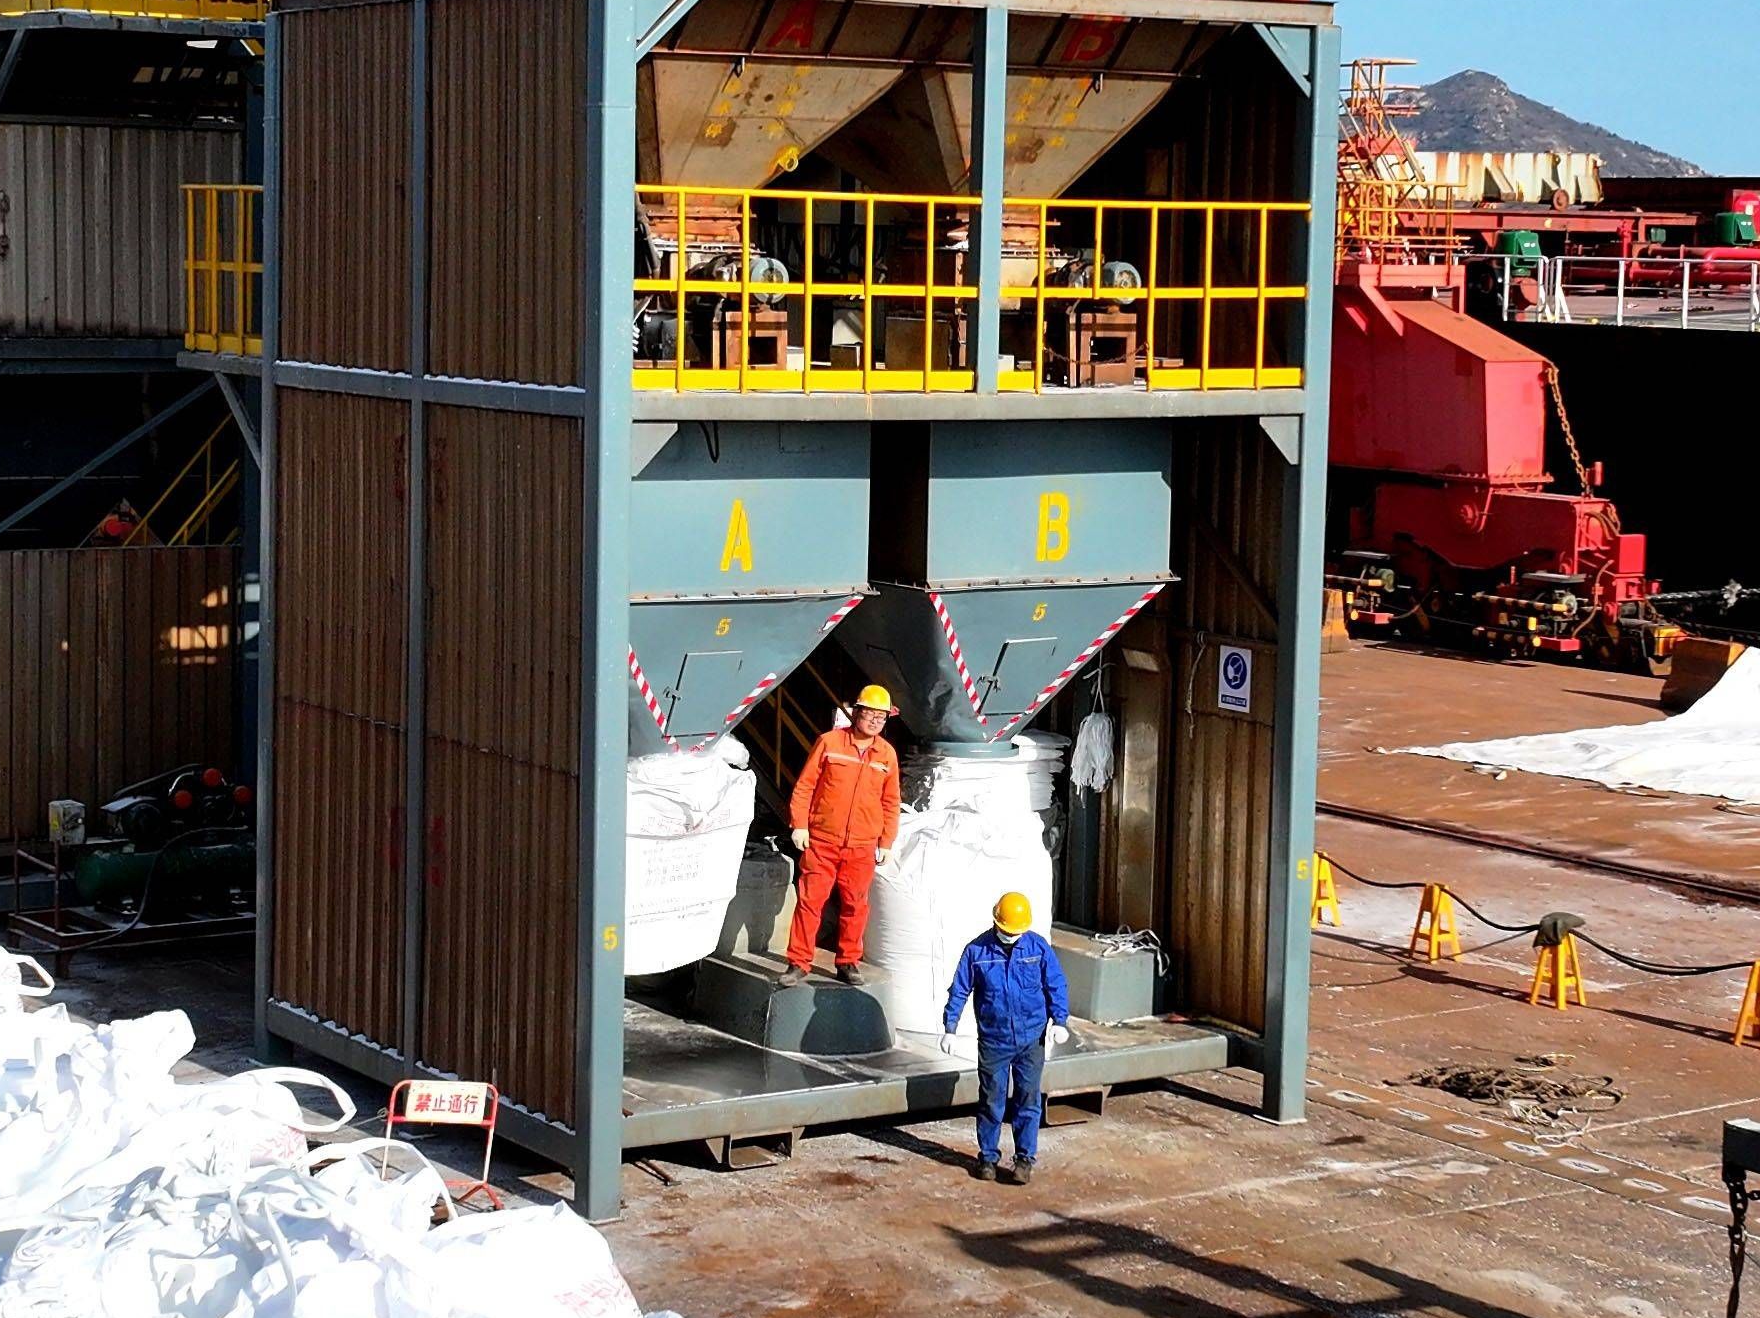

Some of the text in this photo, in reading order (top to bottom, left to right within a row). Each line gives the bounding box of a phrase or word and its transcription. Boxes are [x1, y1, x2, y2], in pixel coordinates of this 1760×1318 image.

[720, 498, 753, 572] A
[1035, 491, 1071, 562] B
[1296, 858, 1310, 881] 5
[602, 924, 619, 951] 5
[414, 1093, 479, 1114] 禁止通行
